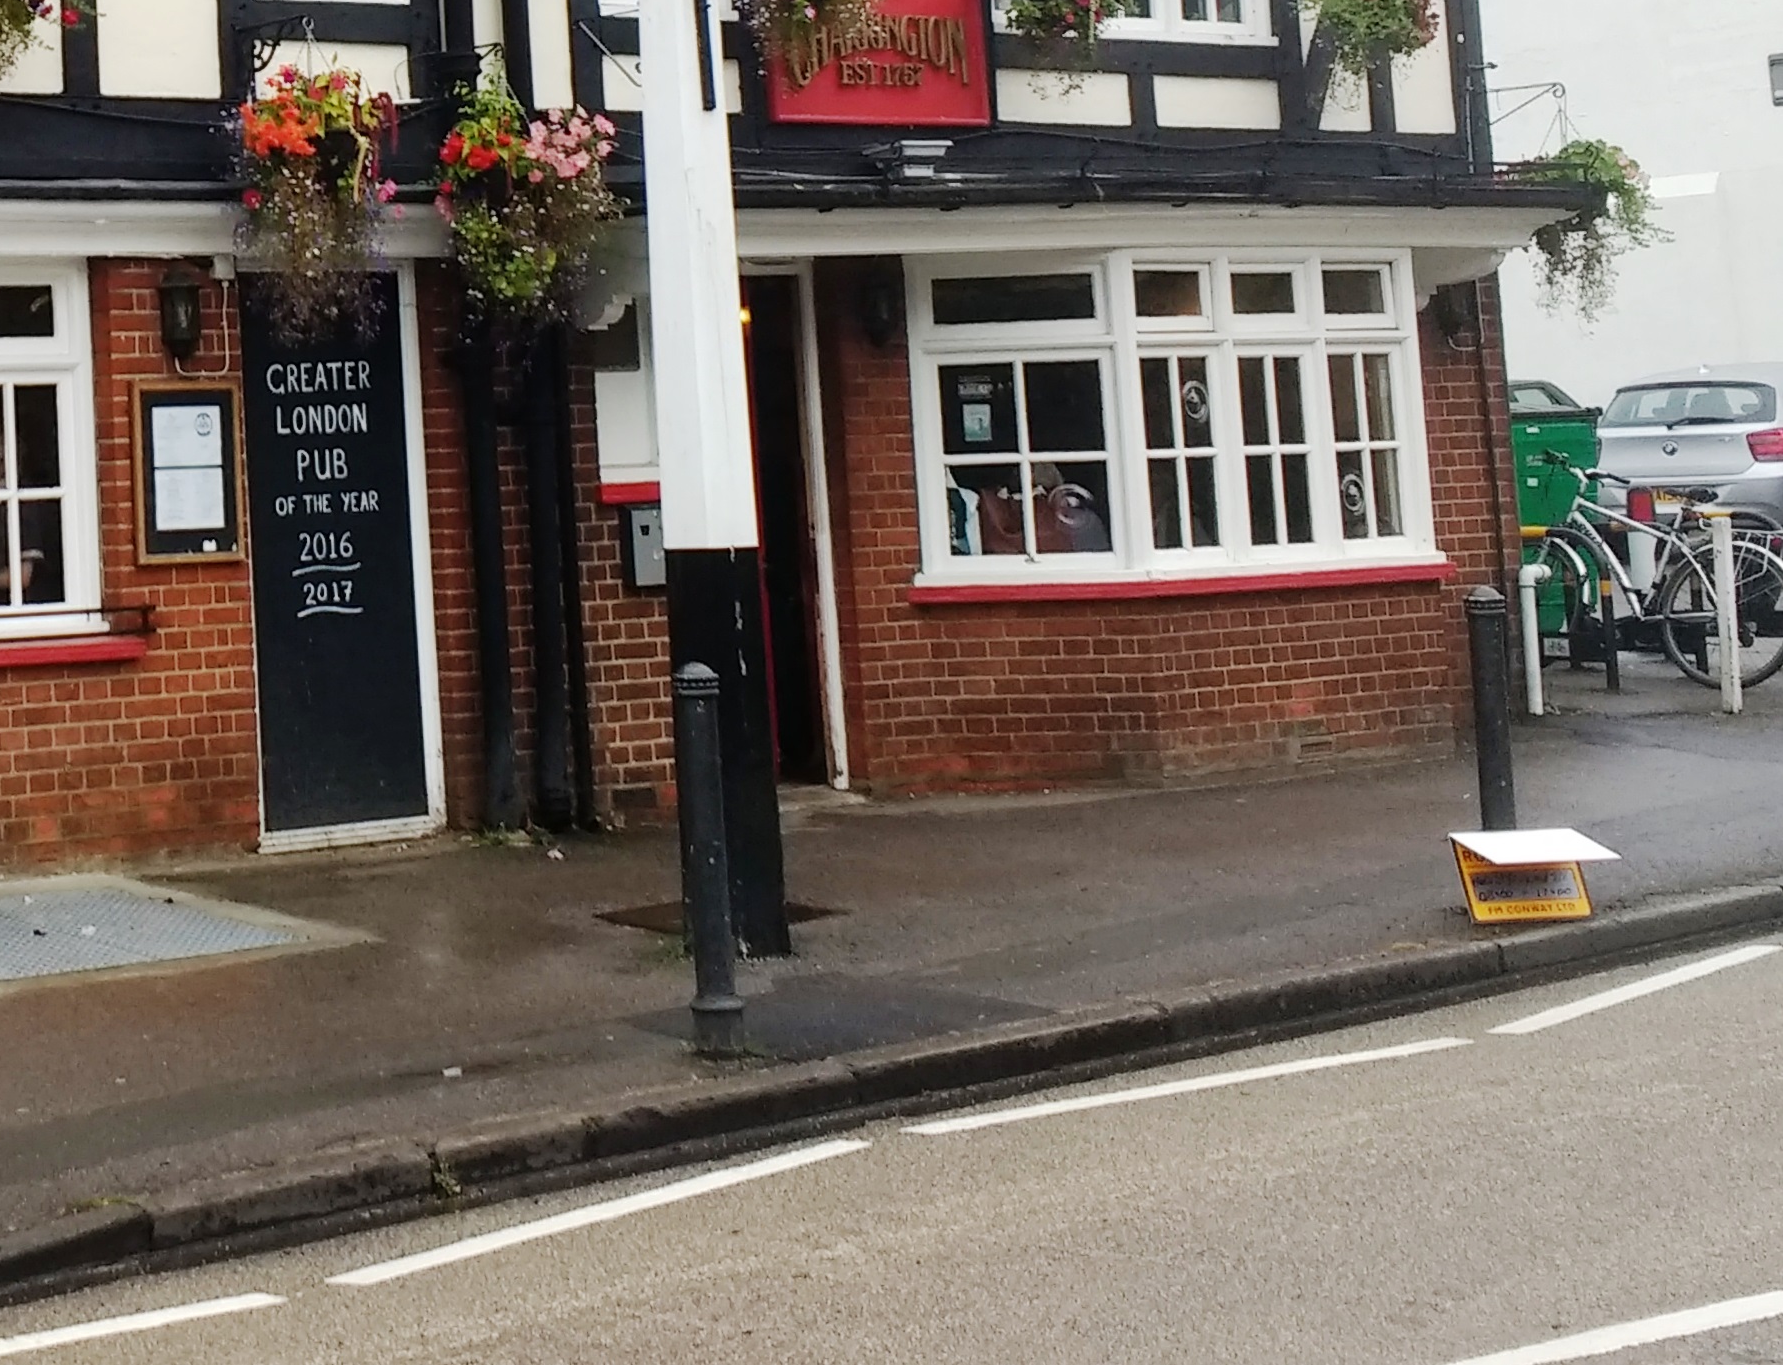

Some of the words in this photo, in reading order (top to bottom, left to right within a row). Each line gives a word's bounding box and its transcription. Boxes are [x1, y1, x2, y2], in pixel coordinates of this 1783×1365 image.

[840, 59, 880, 86] EST
[266, 360, 371, 394] GREATER
[276, 403, 368, 434] LONDON
[297, 448, 348, 483] PUB
[275, 496, 296, 517] OF
[302, 493, 332, 514] THE
[340, 490, 380, 513] YEAR
[298, 532, 354, 562] 2016
[303, 580, 354, 606] 2017
[1506, 903, 1554, 915] CONWAY
